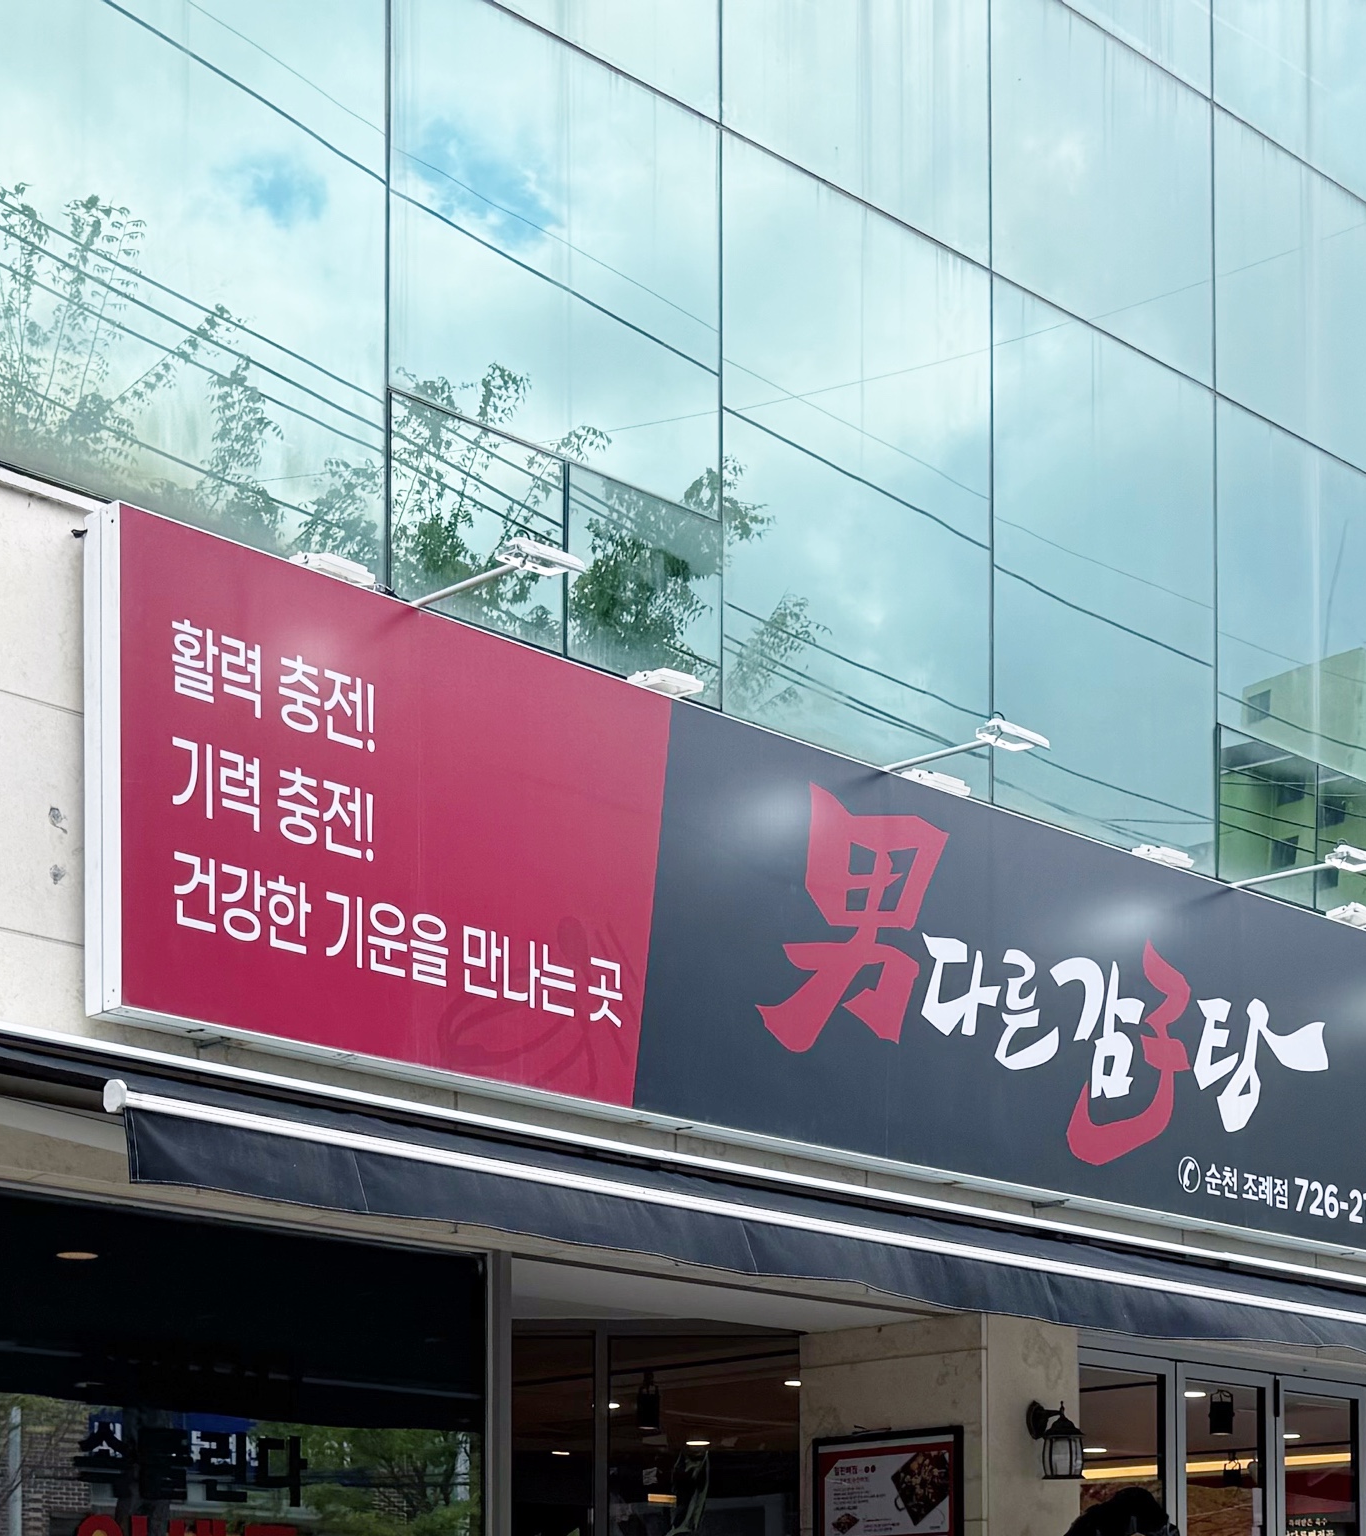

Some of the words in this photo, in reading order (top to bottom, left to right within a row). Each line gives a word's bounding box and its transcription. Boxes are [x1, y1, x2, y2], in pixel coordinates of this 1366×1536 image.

[171, 619, 263, 719] 활력
[278, 654, 375, 753] 충전!
[171, 736, 261, 832] 기력
[277, 767, 374, 862] 충전!
[173, 850, 312, 955] 건강한
[325, 889, 448, 988] 기운을
[462, 924, 575, 1017] 만나는
[587, 956, 623, 1028] 곳
[1205, 1164, 1238, 1201] 순천
[1242, 1171, 1290, 1210] 조례점
